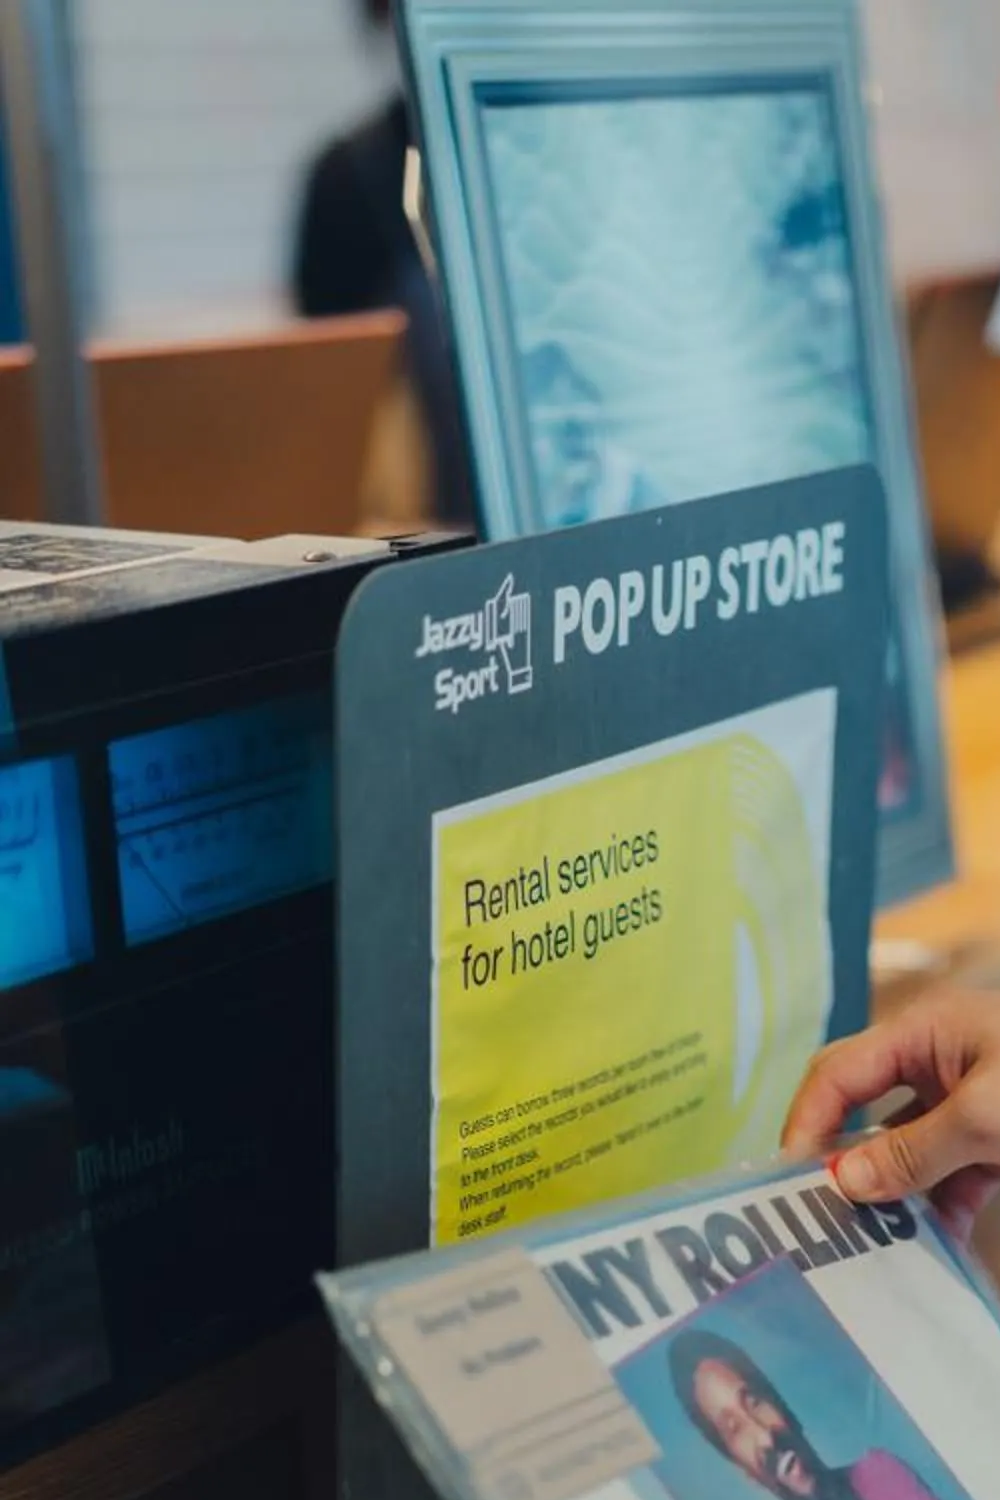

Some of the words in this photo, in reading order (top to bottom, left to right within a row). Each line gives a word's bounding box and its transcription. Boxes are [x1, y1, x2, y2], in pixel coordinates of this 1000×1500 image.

[552, 570, 646, 664] POP
[651, 554, 712, 638] UP
[716, 520, 847, 621] STORE
[414, 606, 484, 658] Jazzy
[434, 656, 500, 715] Sport
[464, 855, 551, 928] Rental
[557, 829, 660, 896] services
[461, 943, 504, 991] for
[511, 910, 576, 975] hotel
[582, 886, 664, 960] guests
[459, 1114, 496, 1139] Guests
[496, 1106, 515, 1125] can
[462, 1140, 496, 1164] Please
[497, 1125, 526, 1150] select
[459, 1190, 489, 1213] When
[542, 1238, 673, 1340] NY
[654, 1183, 918, 1300] ROLLINS
